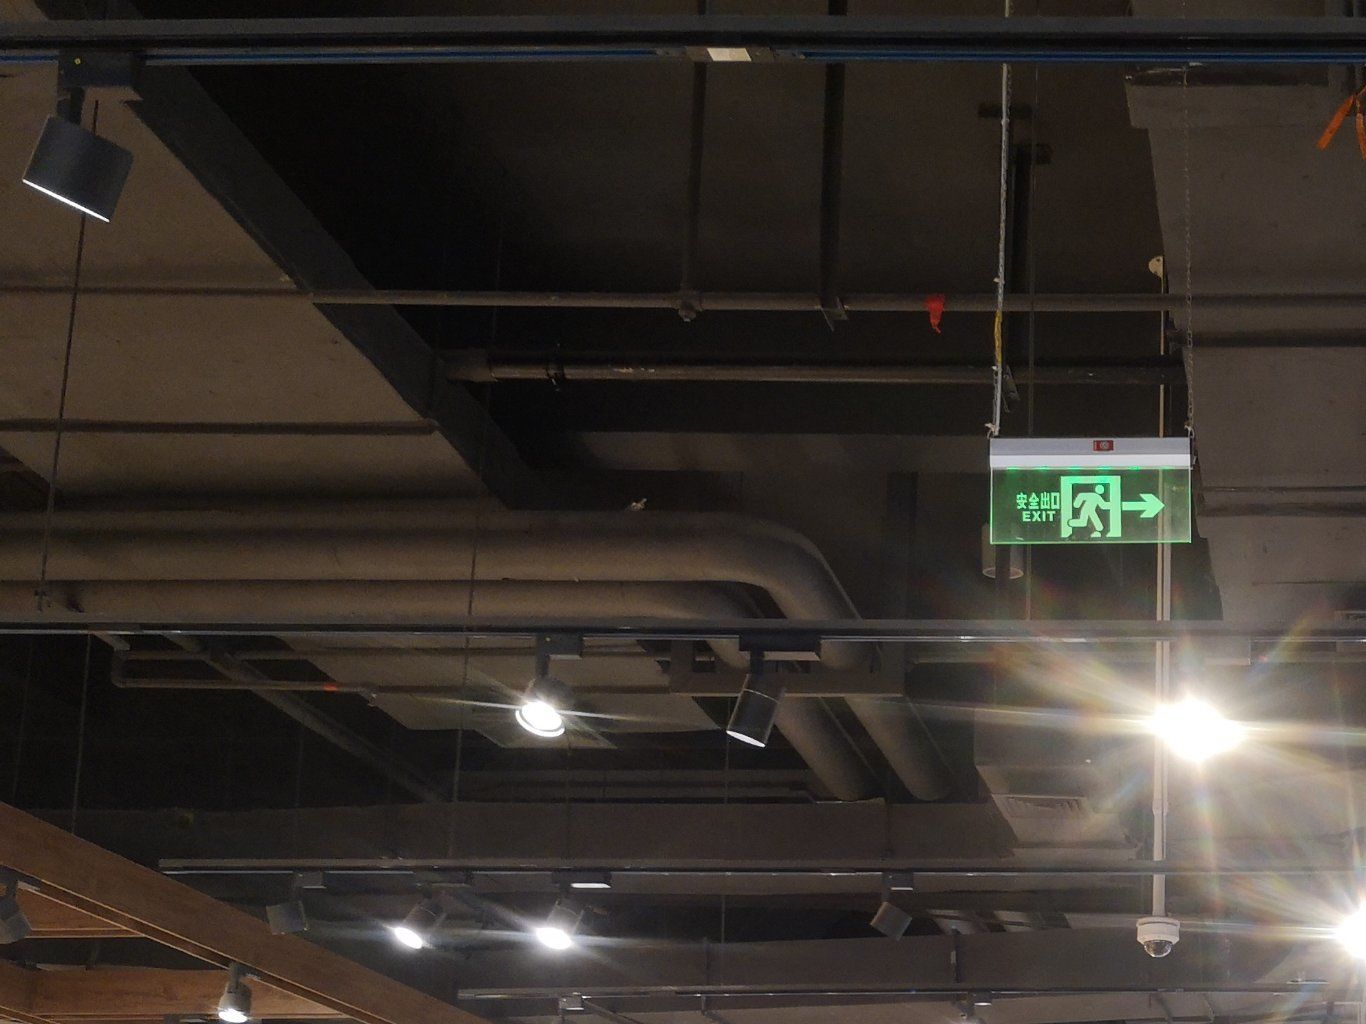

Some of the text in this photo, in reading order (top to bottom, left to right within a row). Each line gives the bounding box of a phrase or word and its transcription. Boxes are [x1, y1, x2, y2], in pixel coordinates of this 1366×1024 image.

[1016, 492, 1060, 510] 安全出口
[1022, 511, 1056, 522] EXIT
